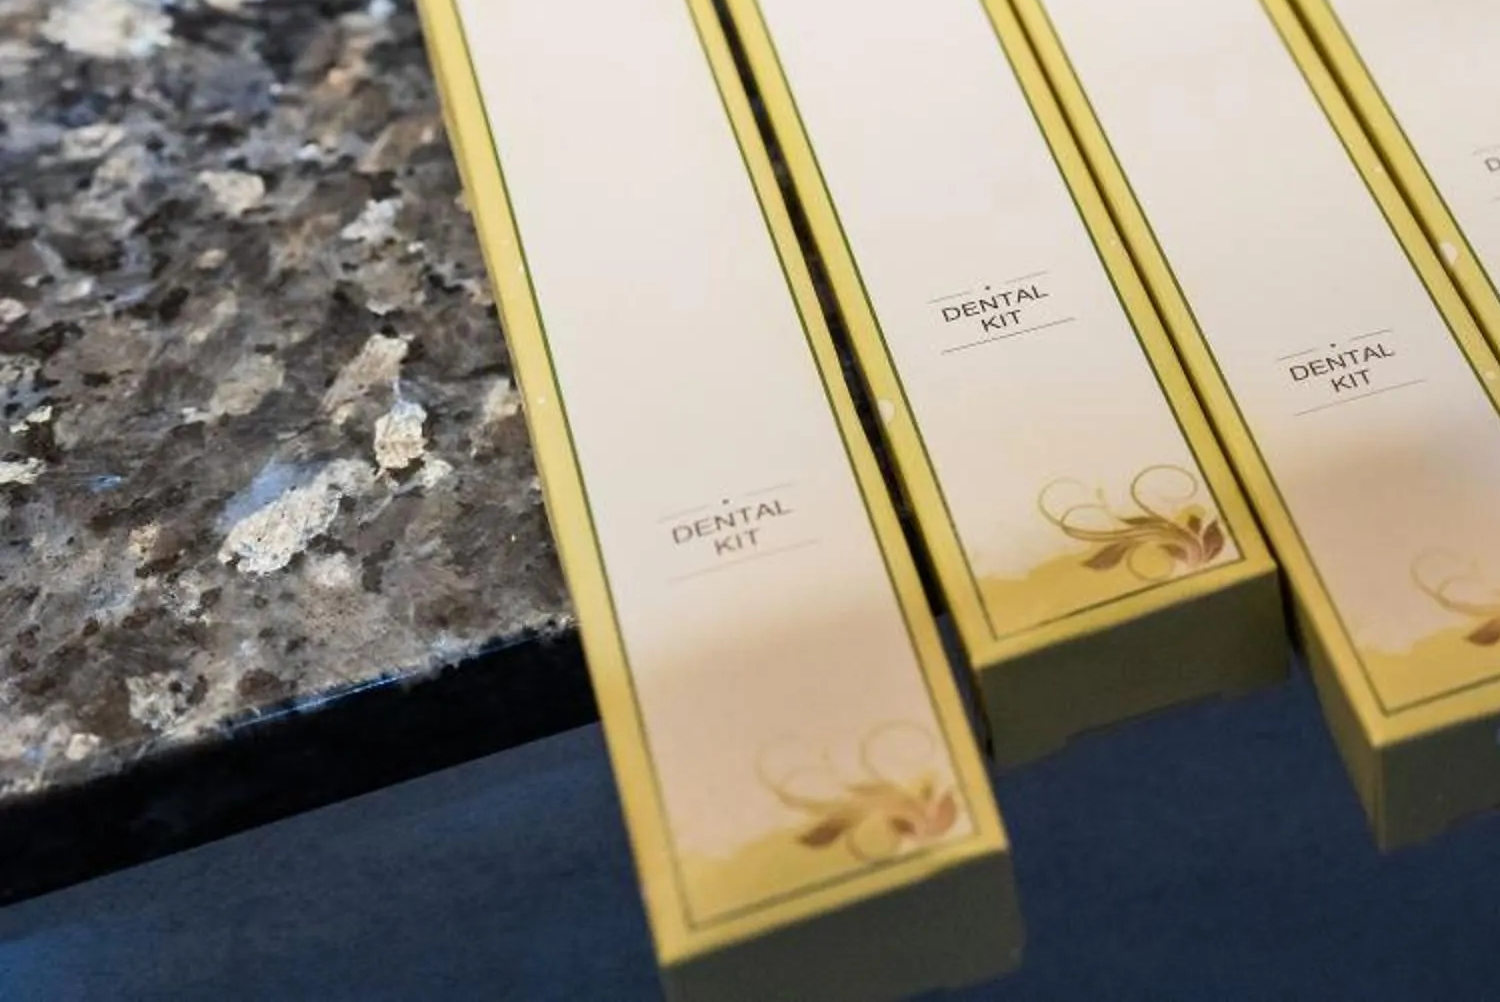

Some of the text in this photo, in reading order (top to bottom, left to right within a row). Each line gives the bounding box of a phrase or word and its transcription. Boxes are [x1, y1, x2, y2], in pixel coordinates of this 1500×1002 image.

[941, 285, 1049, 323] DENTAL
[980, 309, 1021, 332] KIT
[1289, 343, 1396, 382] DENTAL
[1330, 369, 1370, 393] KIT
[672, 499, 795, 544] DENTAL
[713, 528, 760, 555] KIT
